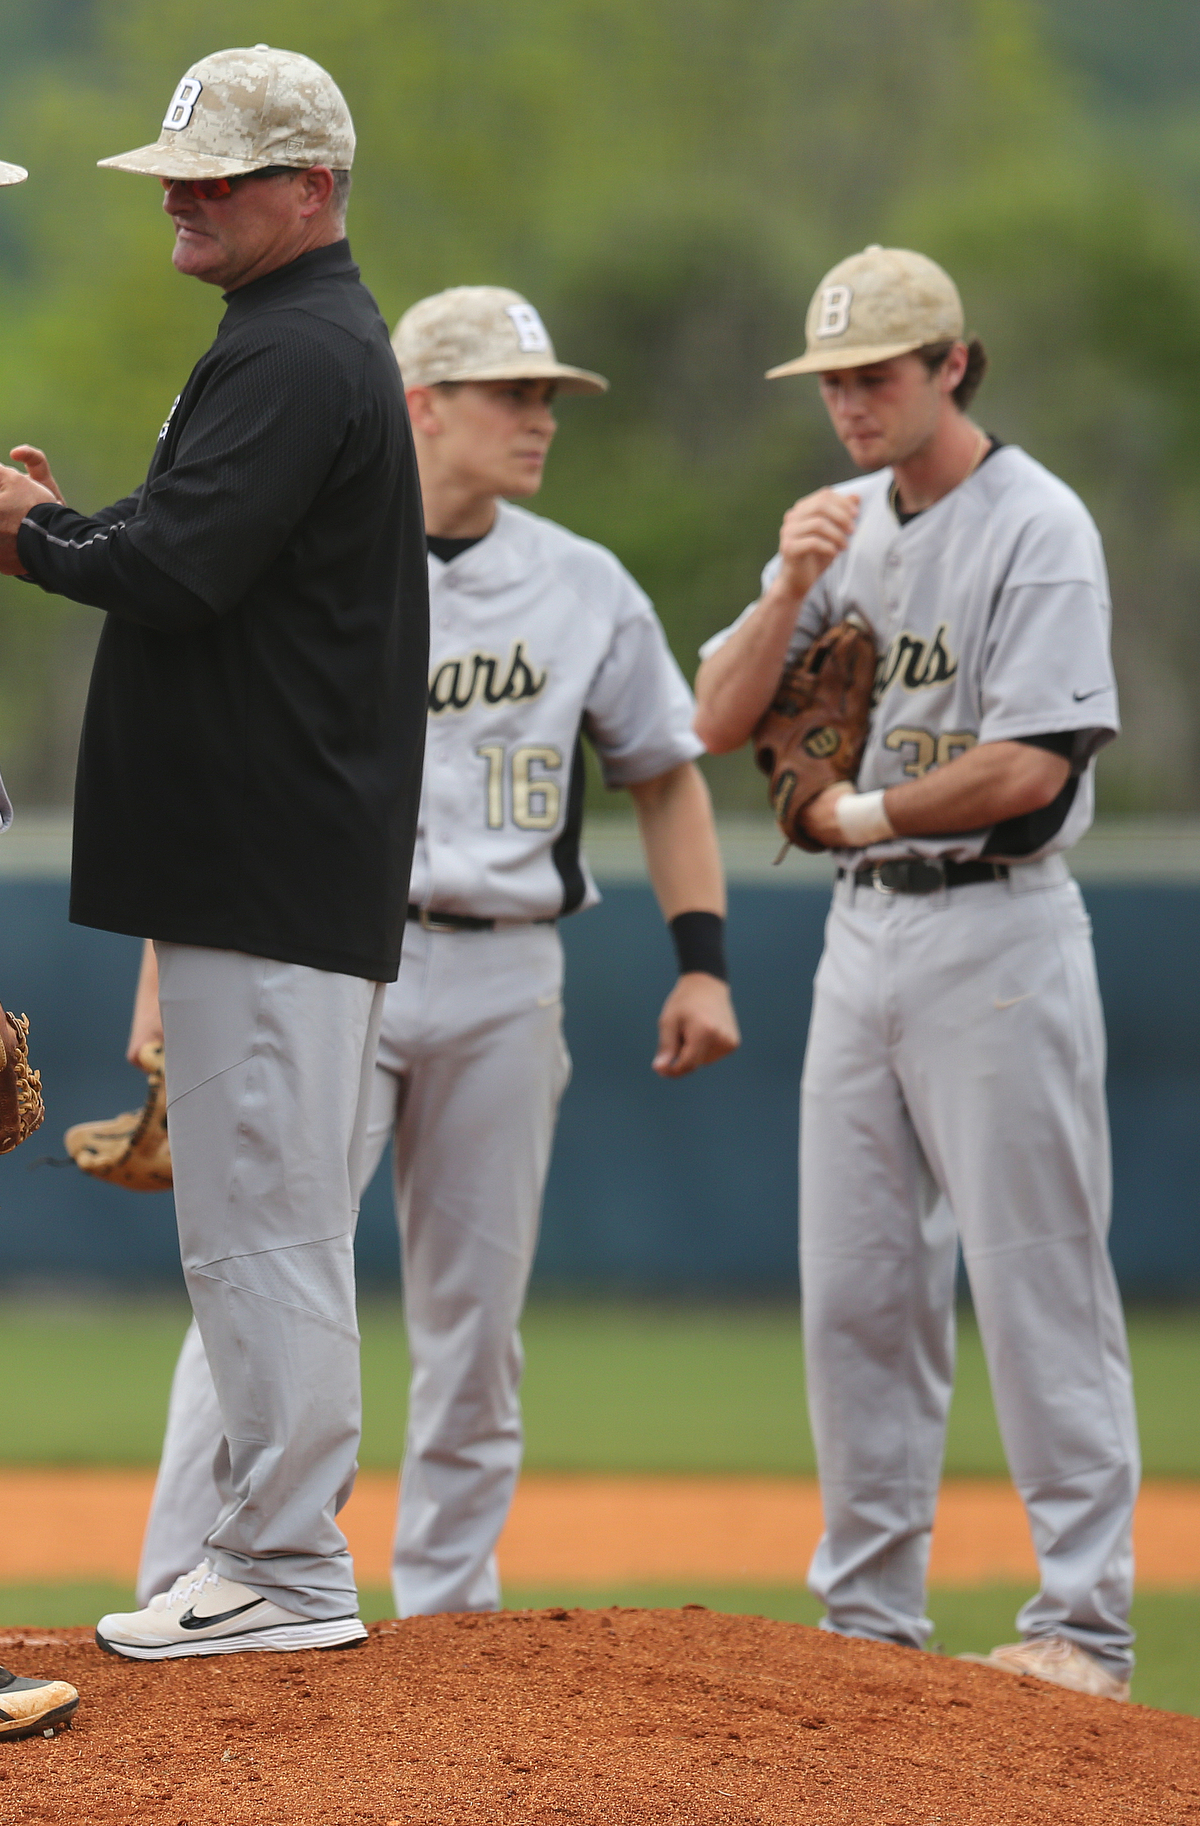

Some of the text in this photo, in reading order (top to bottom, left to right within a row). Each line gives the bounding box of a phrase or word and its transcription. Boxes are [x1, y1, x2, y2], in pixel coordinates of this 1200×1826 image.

[162, 77, 203, 132] B
[503, 303, 551, 353] B
[815, 283, 854, 339] B
[474, 743, 563, 832] 16
